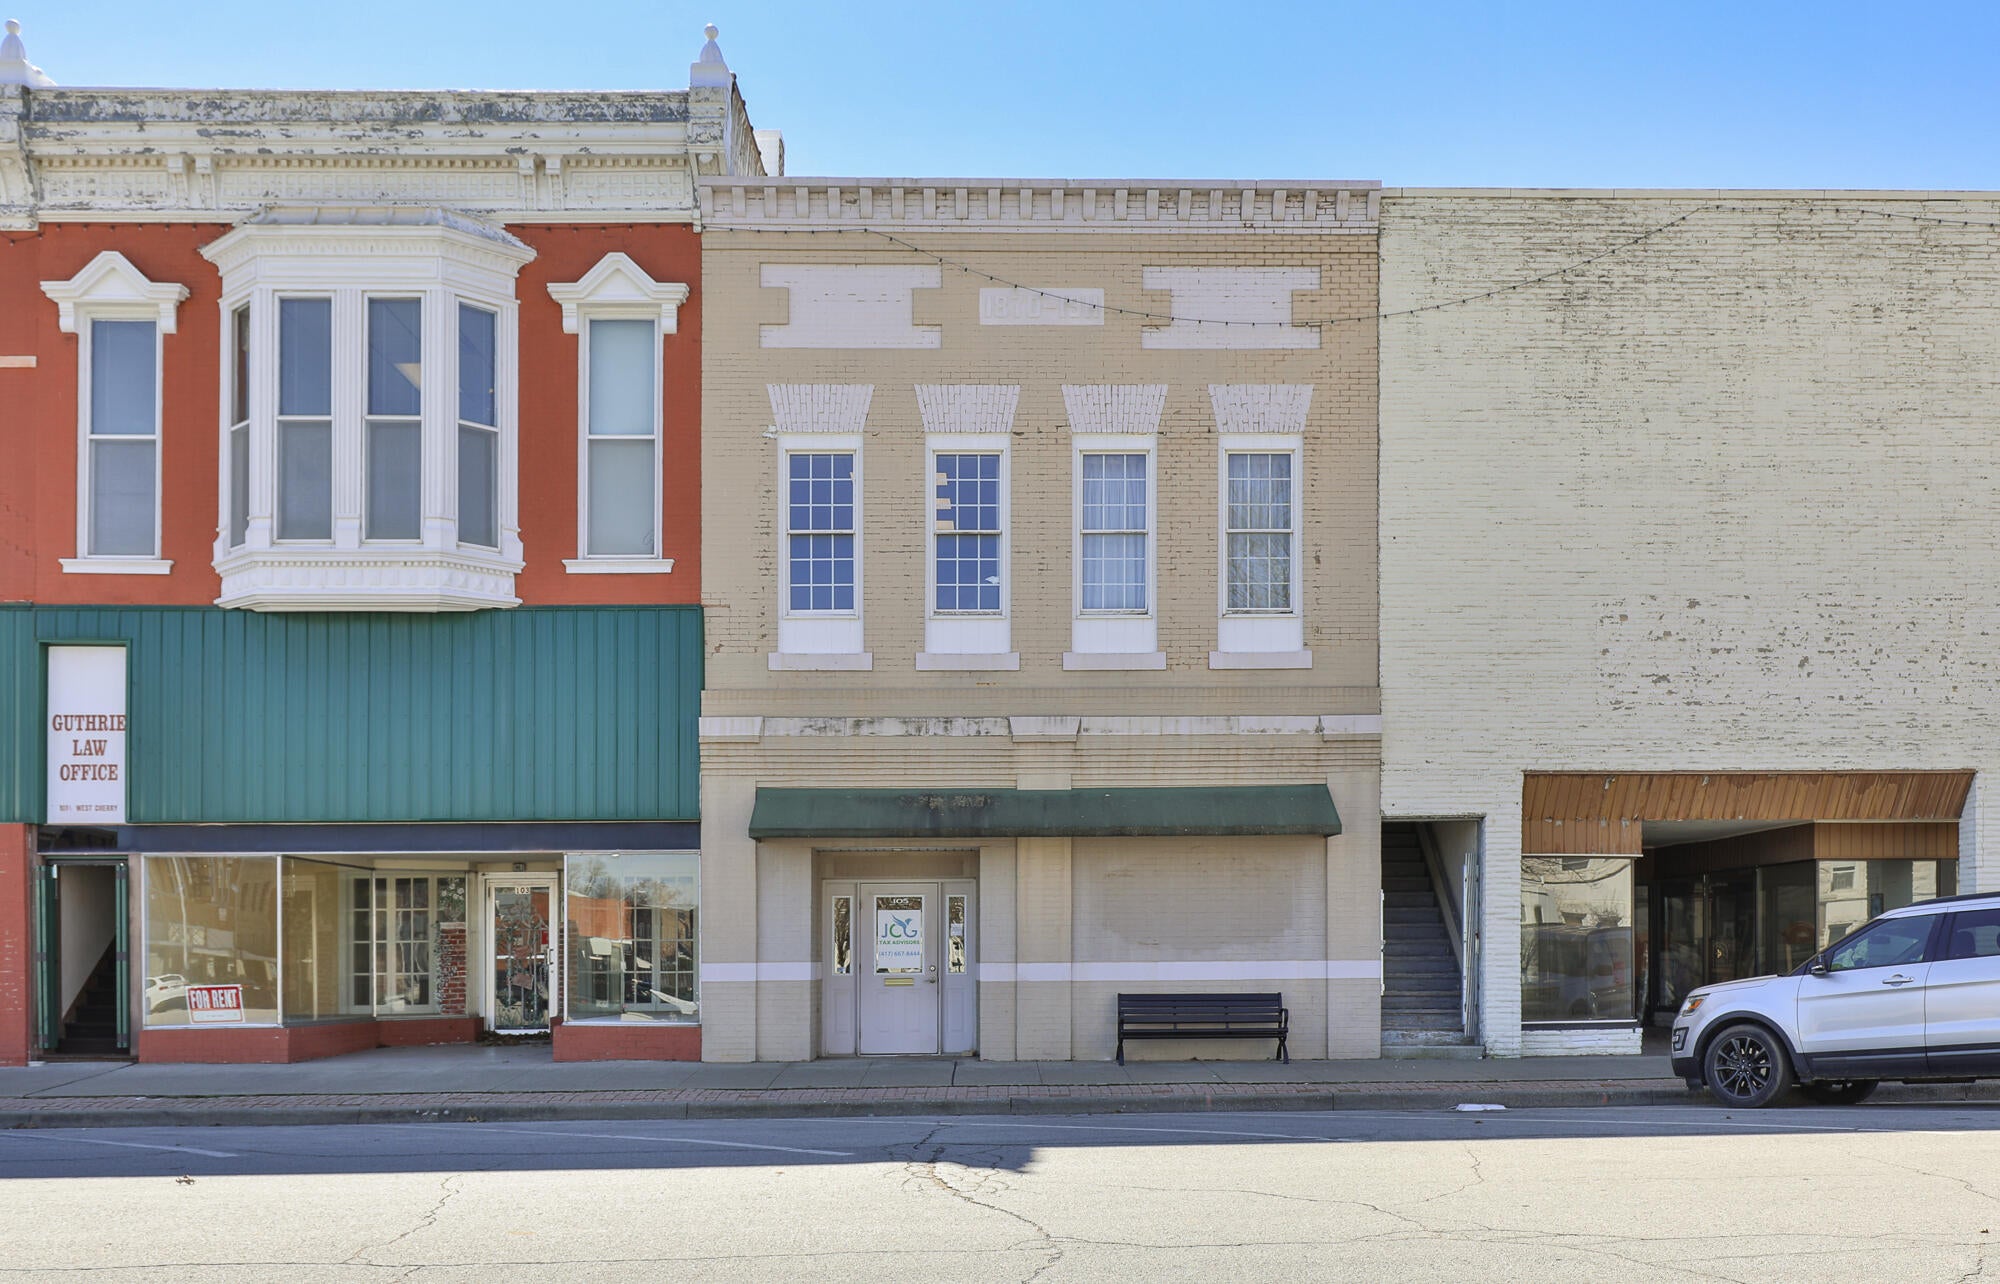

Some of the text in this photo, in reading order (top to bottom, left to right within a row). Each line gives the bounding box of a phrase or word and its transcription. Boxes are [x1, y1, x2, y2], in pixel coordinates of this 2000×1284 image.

[52, 714, 126, 731] GUTHRIE
[72, 739, 107, 756] LAW
[60, 764, 118, 781] OFFICE
[190, 989, 237, 1009] FOR RENT
